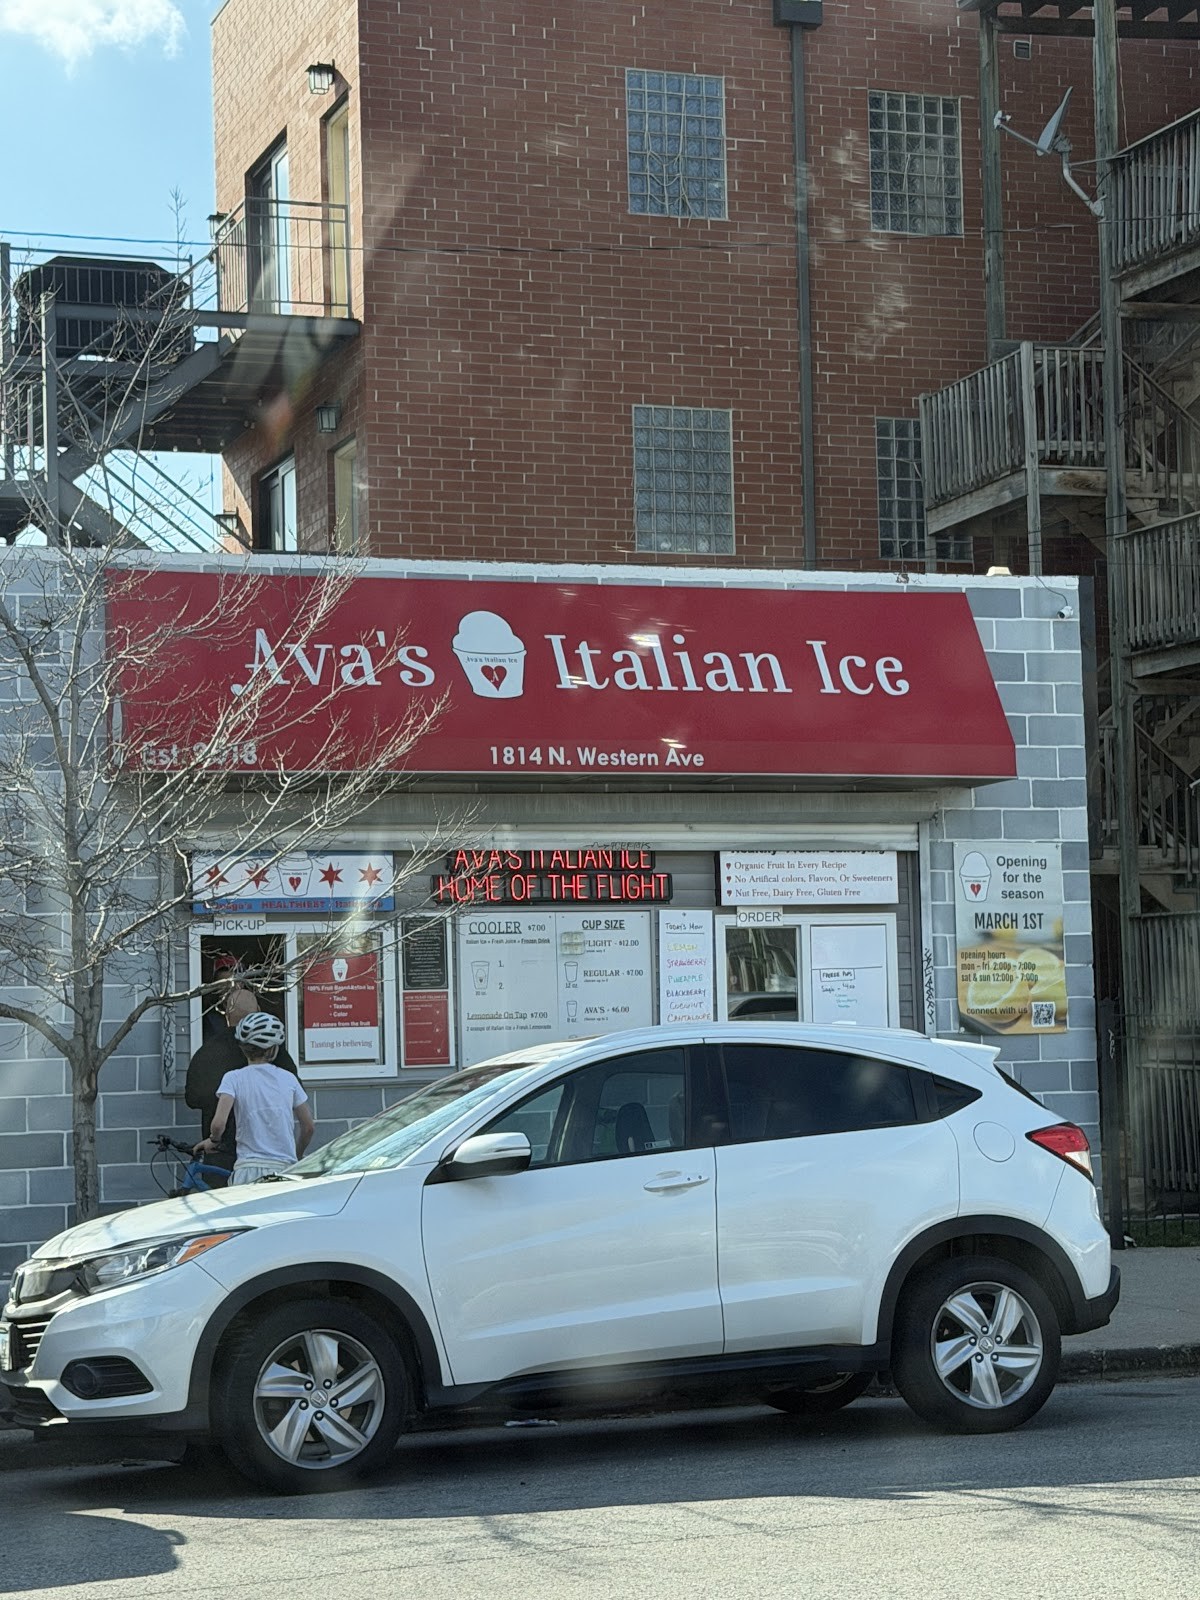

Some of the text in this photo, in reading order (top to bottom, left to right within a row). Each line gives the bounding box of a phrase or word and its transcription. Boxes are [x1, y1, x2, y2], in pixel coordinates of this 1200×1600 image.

[230, 628, 910, 696] Ava's Italian Ice
[193, 741, 258, 765] 218
[489, 746, 705, 766] 1814 N. Western Ave
[621, 849, 652, 869] ICE
[996, 856, 1047, 869] Opening
[734, 861, 847, 871] Organic Fruit In Every Recipe
[735, 875, 746, 883] No
[839, 874, 851, 882] Or
[852, 874, 893, 882] Sweeteners
[1002, 871, 1042, 883] for the
[438, 873, 668, 901] HOME OF THE FLIGHT
[735, 888, 861, 898] Nut Free, Dairy Free, Gluten Free
[1001, 890, 1044, 899] season
[738, 911, 781, 922] ORDER
[974, 912, 1044, 930] MARCH 1ST
[214, 920, 266, 931] PICK-UP
[469, 921, 522, 934] COOLER
[582, 919, 625, 930] CUP SIZE
[961, 950, 1006, 960] opening hours
[982, 962, 990, 970] fri
[961, 973, 971, 982] sat
[973, 973, 978, 982] &
[979, 974, 991, 982] sun
[467, 1011, 502, 1020] Lemonade
[966, 1007, 997, 1015] connect
[1000, 1006, 1016, 1014] with
